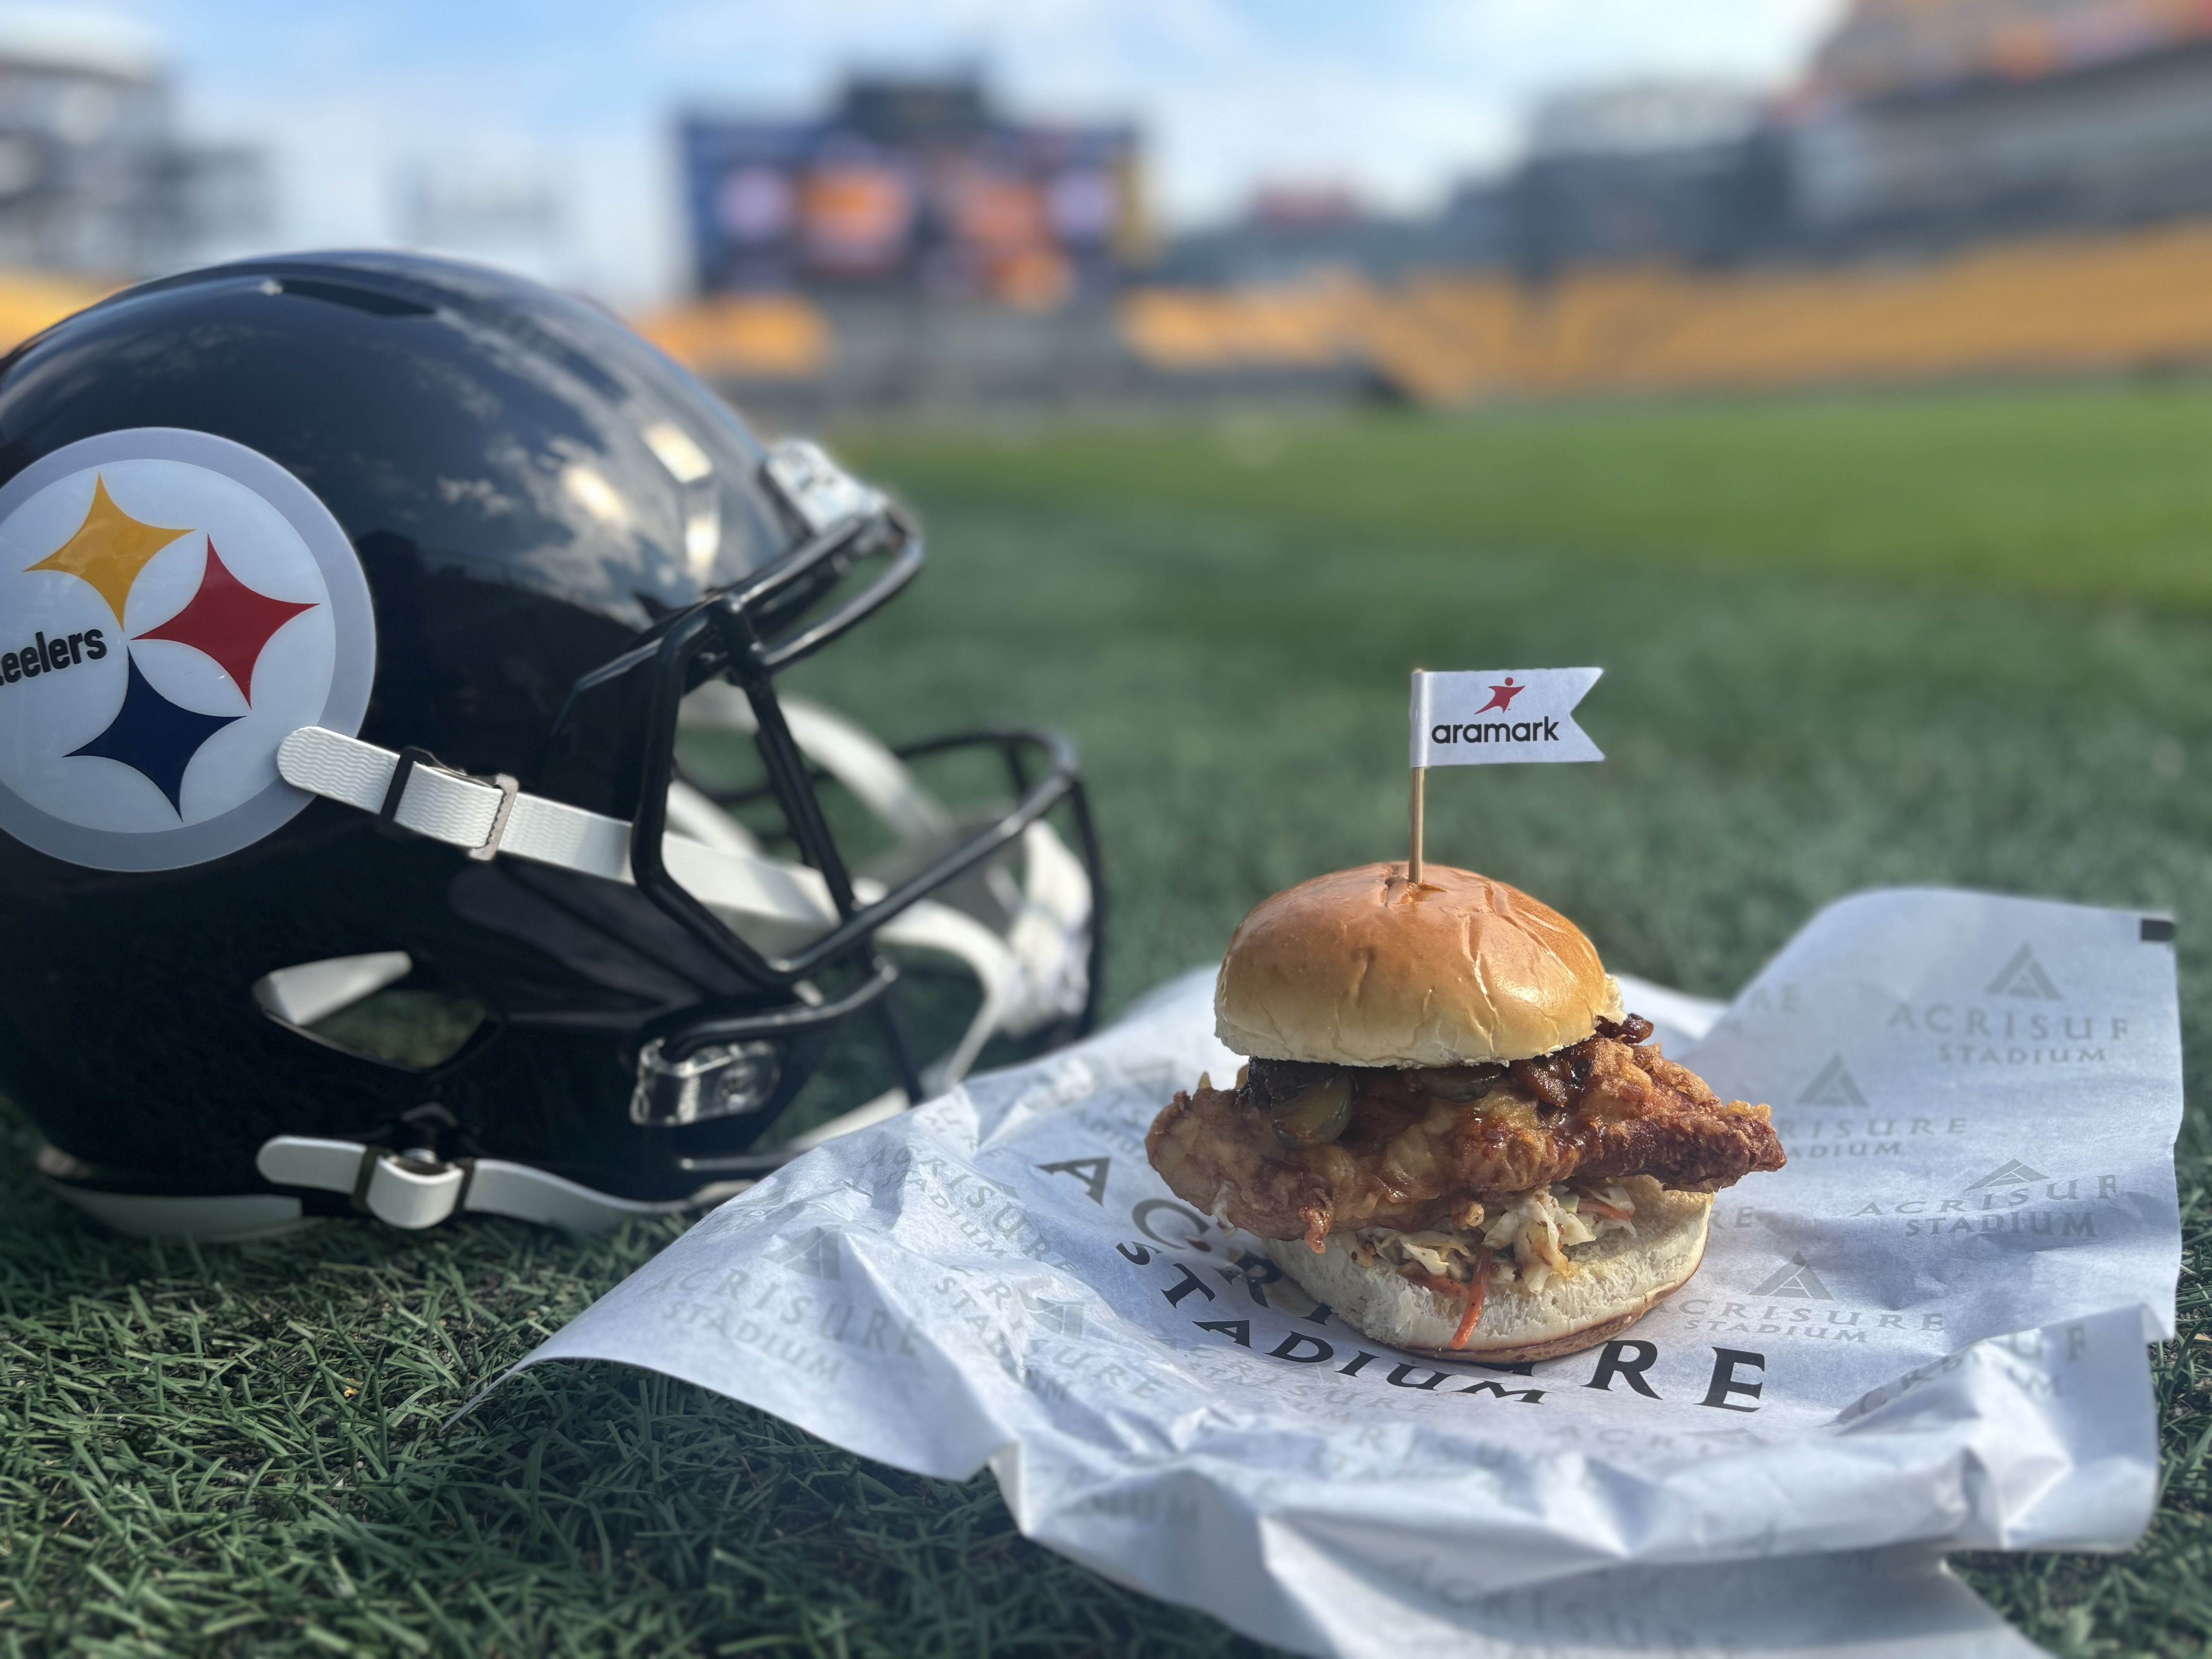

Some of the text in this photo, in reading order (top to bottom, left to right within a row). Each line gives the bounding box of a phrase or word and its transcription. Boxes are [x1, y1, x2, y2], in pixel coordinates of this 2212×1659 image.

[0, 629, 107, 686] eelers
[1431, 716, 1559, 744] aramark
[1937, 1042, 2106, 1065] STADIUM
[1777, 1116, 1966, 1140] RISURE
[1786, 1140, 1901, 1159] ADIUM
[1905, 1211, 2097, 1237] STADIUM
[1115, 1241, 1554, 1405] STADIUM
[1683, 1318, 1867, 1343] STADIUM
